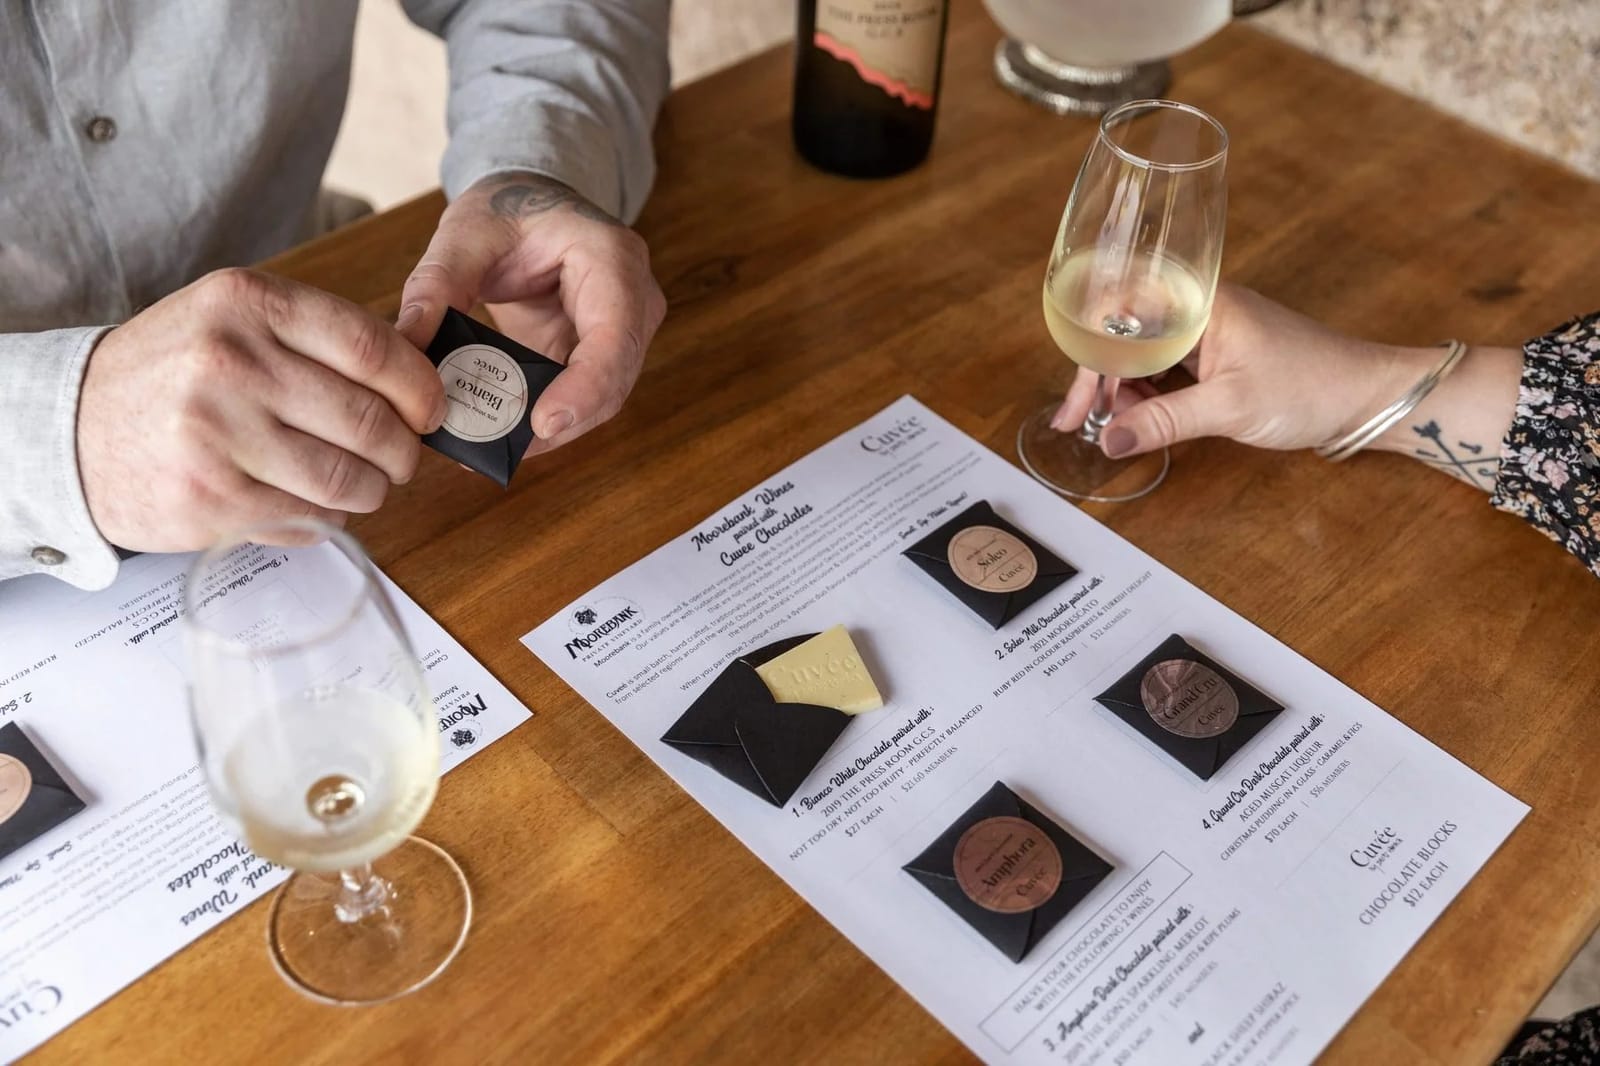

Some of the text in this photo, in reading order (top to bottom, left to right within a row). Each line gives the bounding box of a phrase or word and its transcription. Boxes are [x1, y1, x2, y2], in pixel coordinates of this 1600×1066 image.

[452, 377, 502, 410] Bianco
[859, 416, 918, 452] Cuvée
[690, 503, 755, 551] Moorebank
[754, 481, 794, 505] Wines
[719, 540, 755, 566] Cuvee
[754, 503, 812, 543] Chocolates
[732, 507, 777, 543] paired with
[977, 548, 1007, 569] Soleo
[118, 587, 159, 609] MEMBERS
[125, 593, 170, 621] PERFECTLY
[129, 558, 281, 644] Bianco White paired with
[994, 577, 1102, 659] 2. Soleo Milk Chocolate paired with
[74, 619, 122, 647] BALANCED
[582, 618, 642, 661] PRIVATE VINEYARD
[593, 641, 630, 667] Moorebank
[640, 620, 661, 633] family
[635, 640, 648, 650] Our
[1029, 599, 1098, 652] 2021 MOORESCATO
[614, 691, 633, 704] from
[632, 671, 659, 693] selected
[659, 656, 683, 674] regions
[682, 639, 705, 657] around
[704, 632, 716, 641] the
[632, 665, 651, 680] small
[669, 640, 687, 653] hand
[679, 675, 701, 690] When
[700, 666, 713, 677] you
[712, 657, 725, 668] pair
[725, 646, 743, 658] these
[992, 680, 1011, 697] RUBY
[1010, 670, 1025, 682] RED
[1023, 663, 1033, 672] IN
[1043, 664, 1058, 676] $40
[1056, 650, 1077, 666] EACH
[19, 691, 32, 703] 2.
[438, 693, 487, 732] MOORE
[440, 691, 470, 711] PRIVATE
[1162, 688, 1199, 719] Grand
[789, 843, 807, 860] NOT
[807, 829, 826, 845] TOO
[843, 800, 861, 816] NOT
[861, 787, 879, 802] TOO
[878, 766, 904, 789] FRUITY
[908, 732, 946, 765] PERFECTLY
[945, 704, 982, 735] BALANCED
[792, 708, 931, 817] 1. Bianco White Chocolate paired with
[820, 799, 841, 817] 2019
[839, 785, 861, 800] THE
[859, 765, 886, 787] PRESS
[884, 743, 914, 767] ROOM
[1202, 715, 1322, 829] 4. Grand Cru Dark Chocolate paired with
[1239, 740, 1323, 821] AGED MUSCAT LIQUEUR
[844, 822, 860, 837] $27
[860, 805, 883, 824] EACH
[924, 746, 957, 774] MEMBERS
[1220, 824, 1257, 860] CHRISTMAS
[1254, 796, 1285, 827] PUDDING
[1282, 788, 1293, 799] IN
[1296, 766, 1316, 786] GLASS
[1316, 738, 1345, 765] CARAMEL
[1347, 722, 1362, 736] FIGS
[1264, 759, 1350, 842] $70 EACH $56 MEMBERS
[981, 837, 1037, 886] Amphora
[1349, 826, 1395, 867] Cuvée
[214, 864, 239, 885] with
[1358, 858, 1422, 924] CHOCOLATE
[1416, 820, 1457, 861] BLOCKS
[1402, 861, 1448, 906] $12 EACH
[180, 889, 238, 926] Wines
[1041, 960, 1067, 984] YOUR
[1065, 913, 1117, 961] CHOCOLATE
[1113, 901, 1128, 914] TO
[1125, 878, 1152, 903] ENJOY
[1057, 971, 1076, 988] THE
[1074, 925, 1123, 972] FOLLOWING
[1127, 896, 1154, 919] WINES
[1092, 976, 1120, 1000] Dark
[1115, 943, 1153, 981] Chocolate
[1151, 919, 1176, 951] paired
[1173, 906, 1191, 924] with
[1173, 916, 1208, 951] MERLOT
